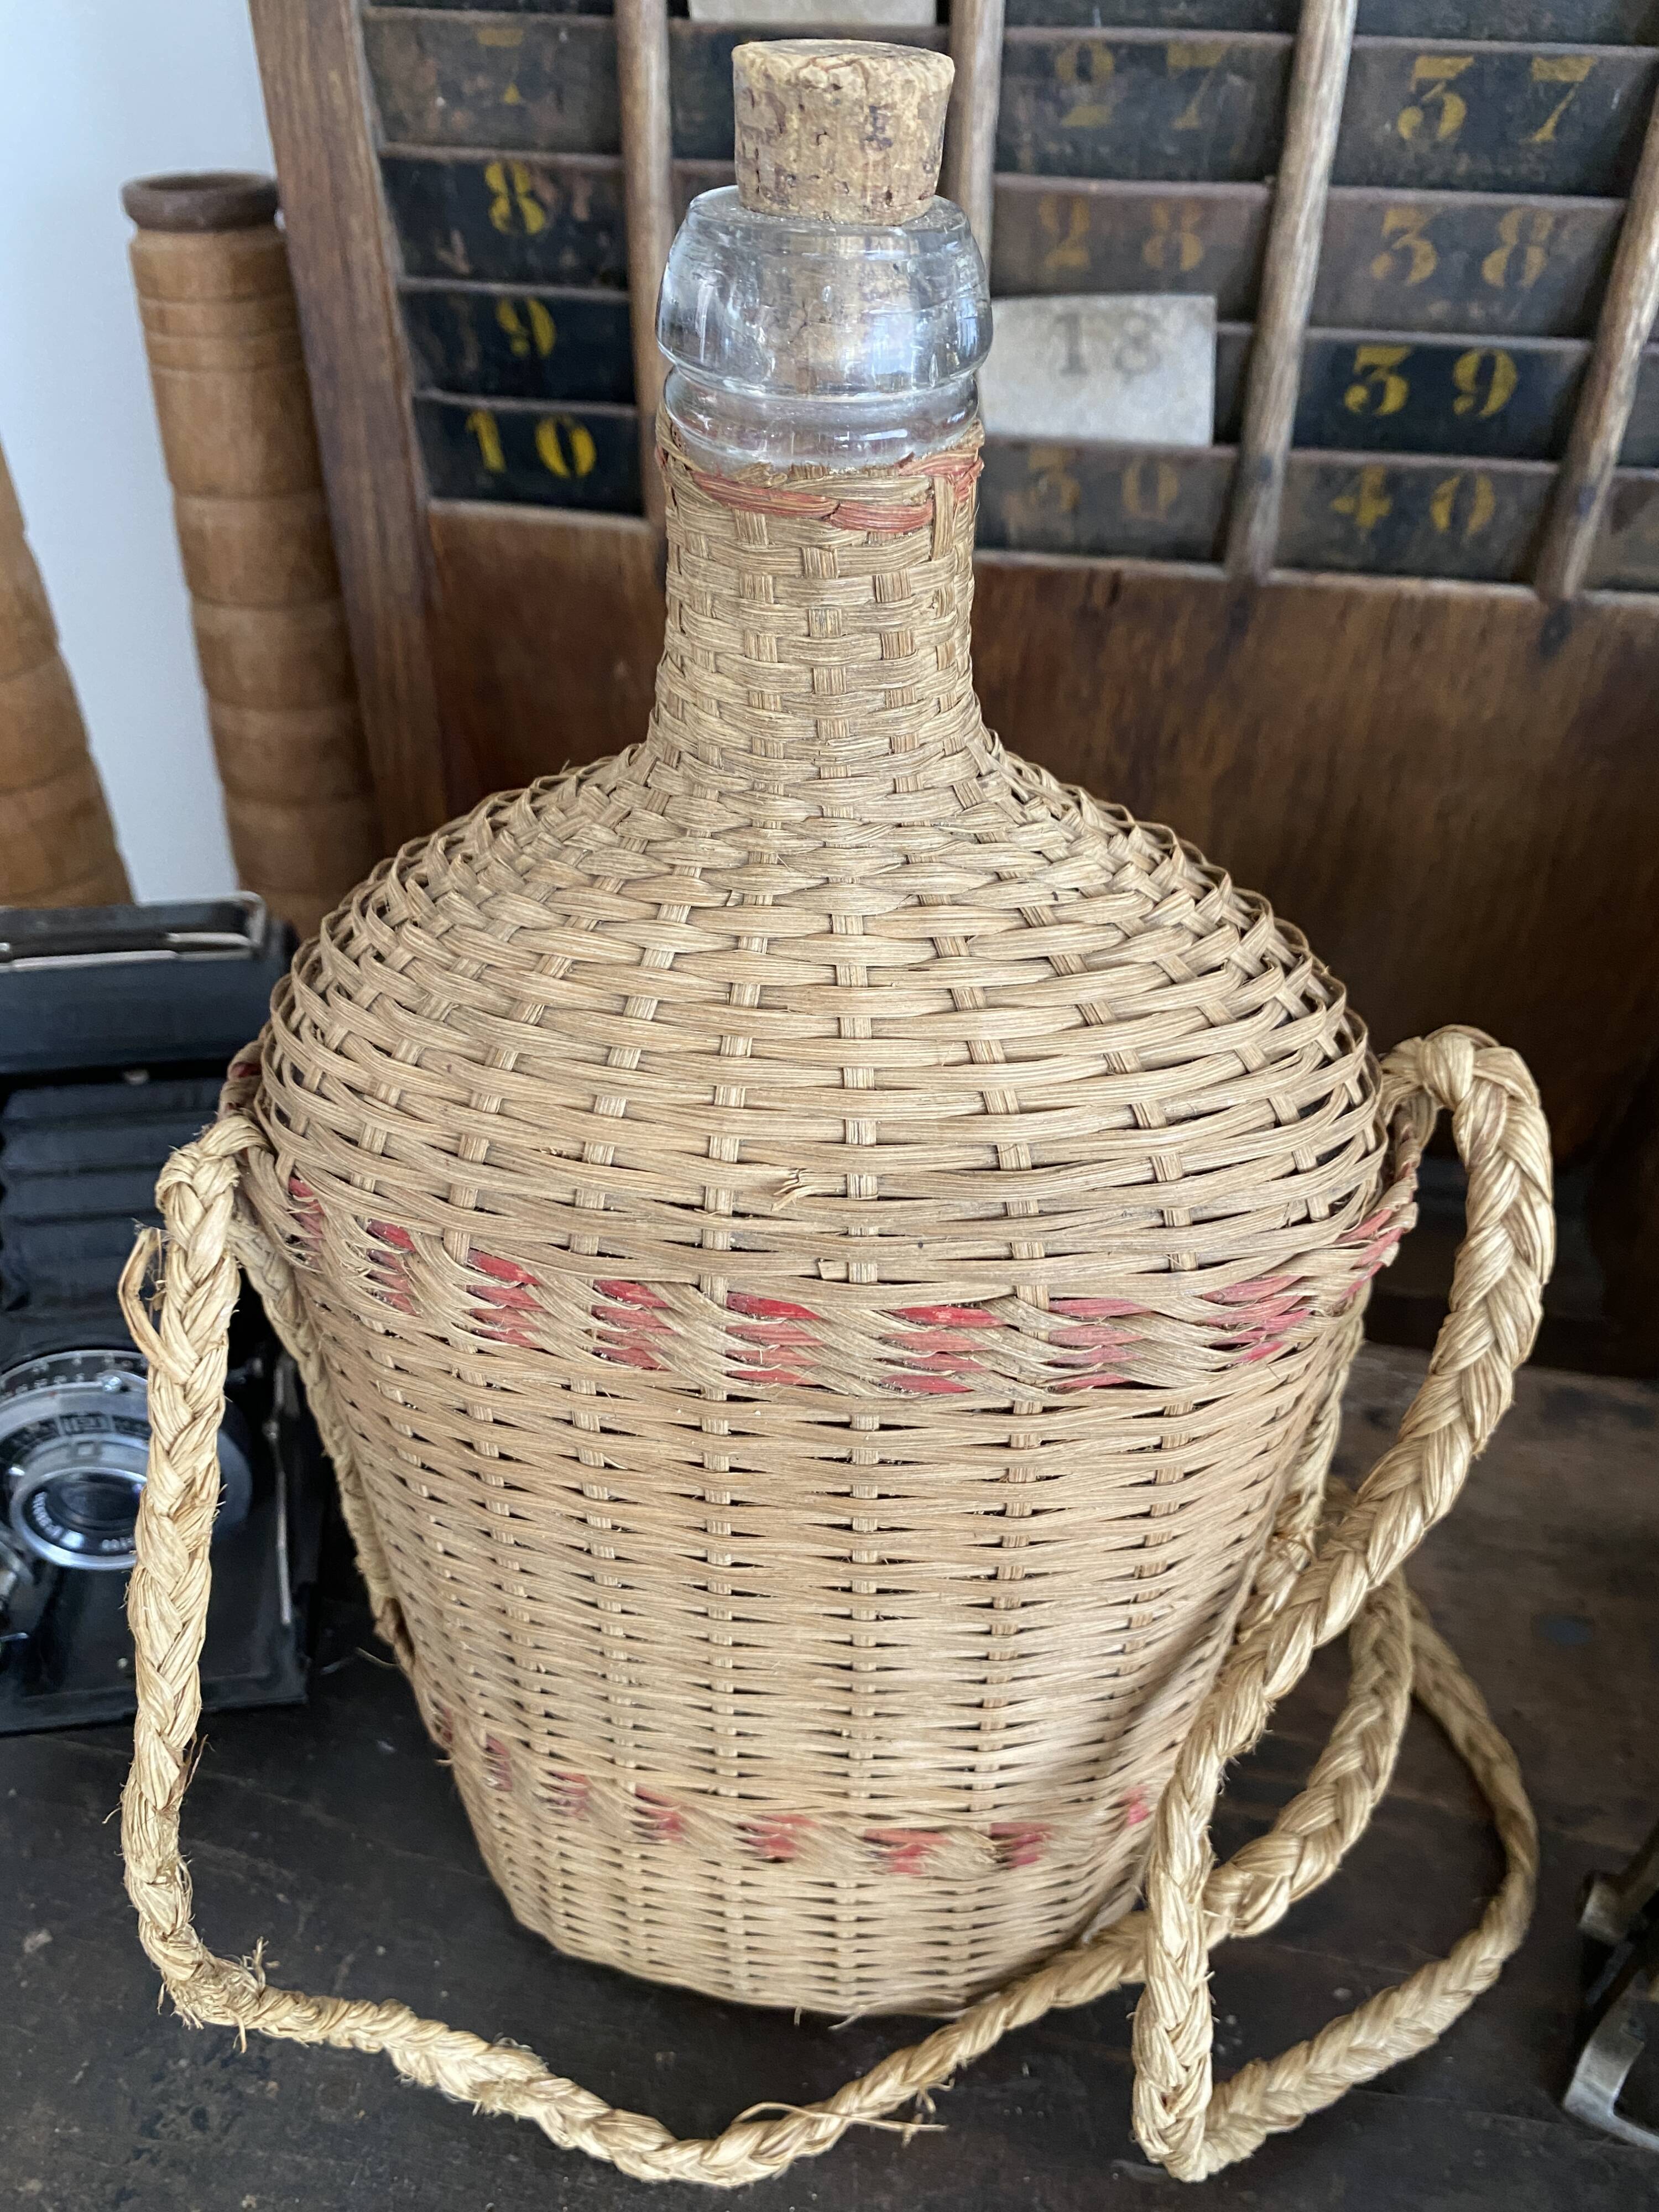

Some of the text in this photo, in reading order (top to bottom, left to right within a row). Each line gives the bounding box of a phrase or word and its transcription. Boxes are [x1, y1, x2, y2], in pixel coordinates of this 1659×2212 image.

[1397, 55, 1597, 144] 37
[484, 161, 546, 234] 8
[1039, 194, 1204, 272] 28
[1370, 207, 1554, 289] 38
[497, 298, 555, 358] 9
[1047, 311, 1161, 382] 18
[1344, 345, 1519, 417] 39
[466, 409, 597, 479] 10
[1331, 465, 1496, 536] 40
